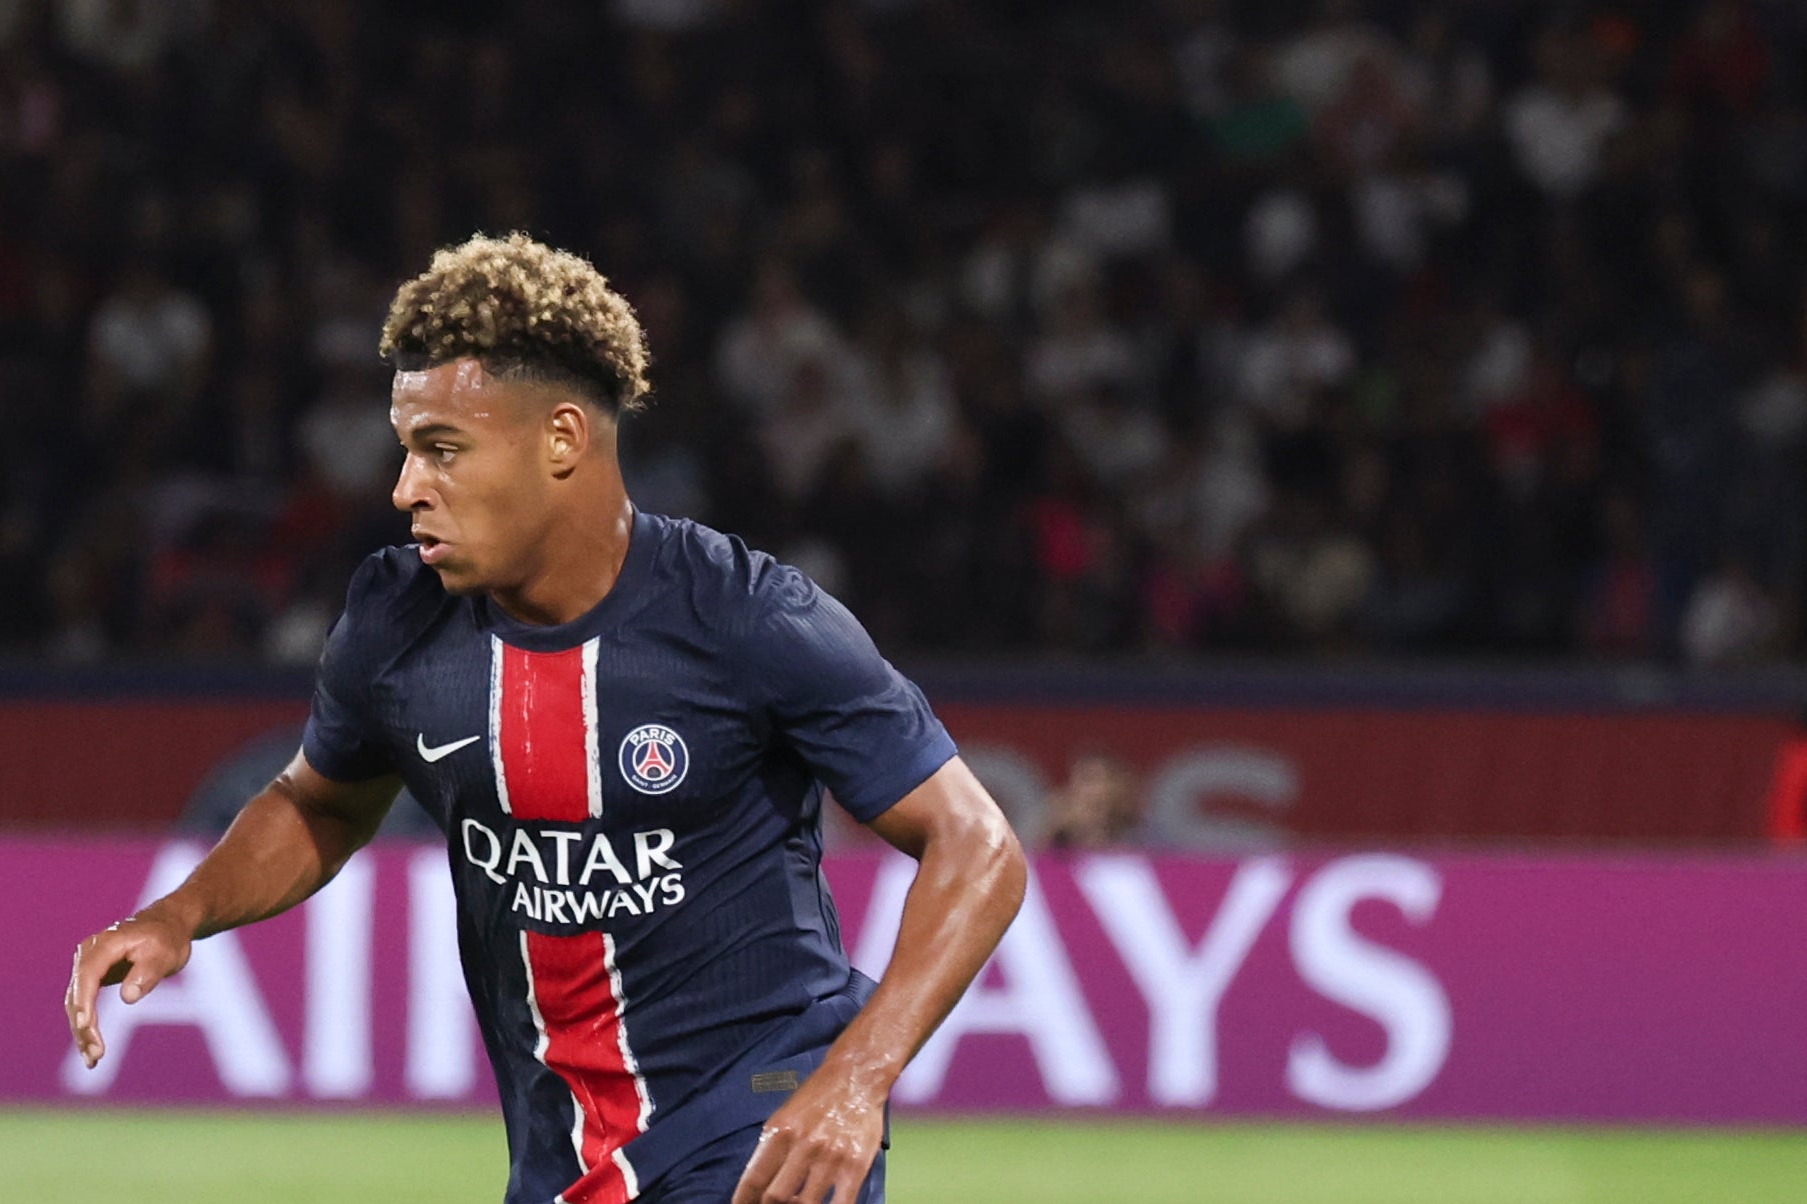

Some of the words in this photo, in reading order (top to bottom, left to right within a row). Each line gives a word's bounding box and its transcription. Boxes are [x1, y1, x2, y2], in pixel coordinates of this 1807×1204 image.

[629, 728, 676, 746] PARIS
[461, 818, 684, 885] QATAR
[511, 872, 686, 925] AIRWAYS
[61, 838, 1453, 1112] AIAYS
